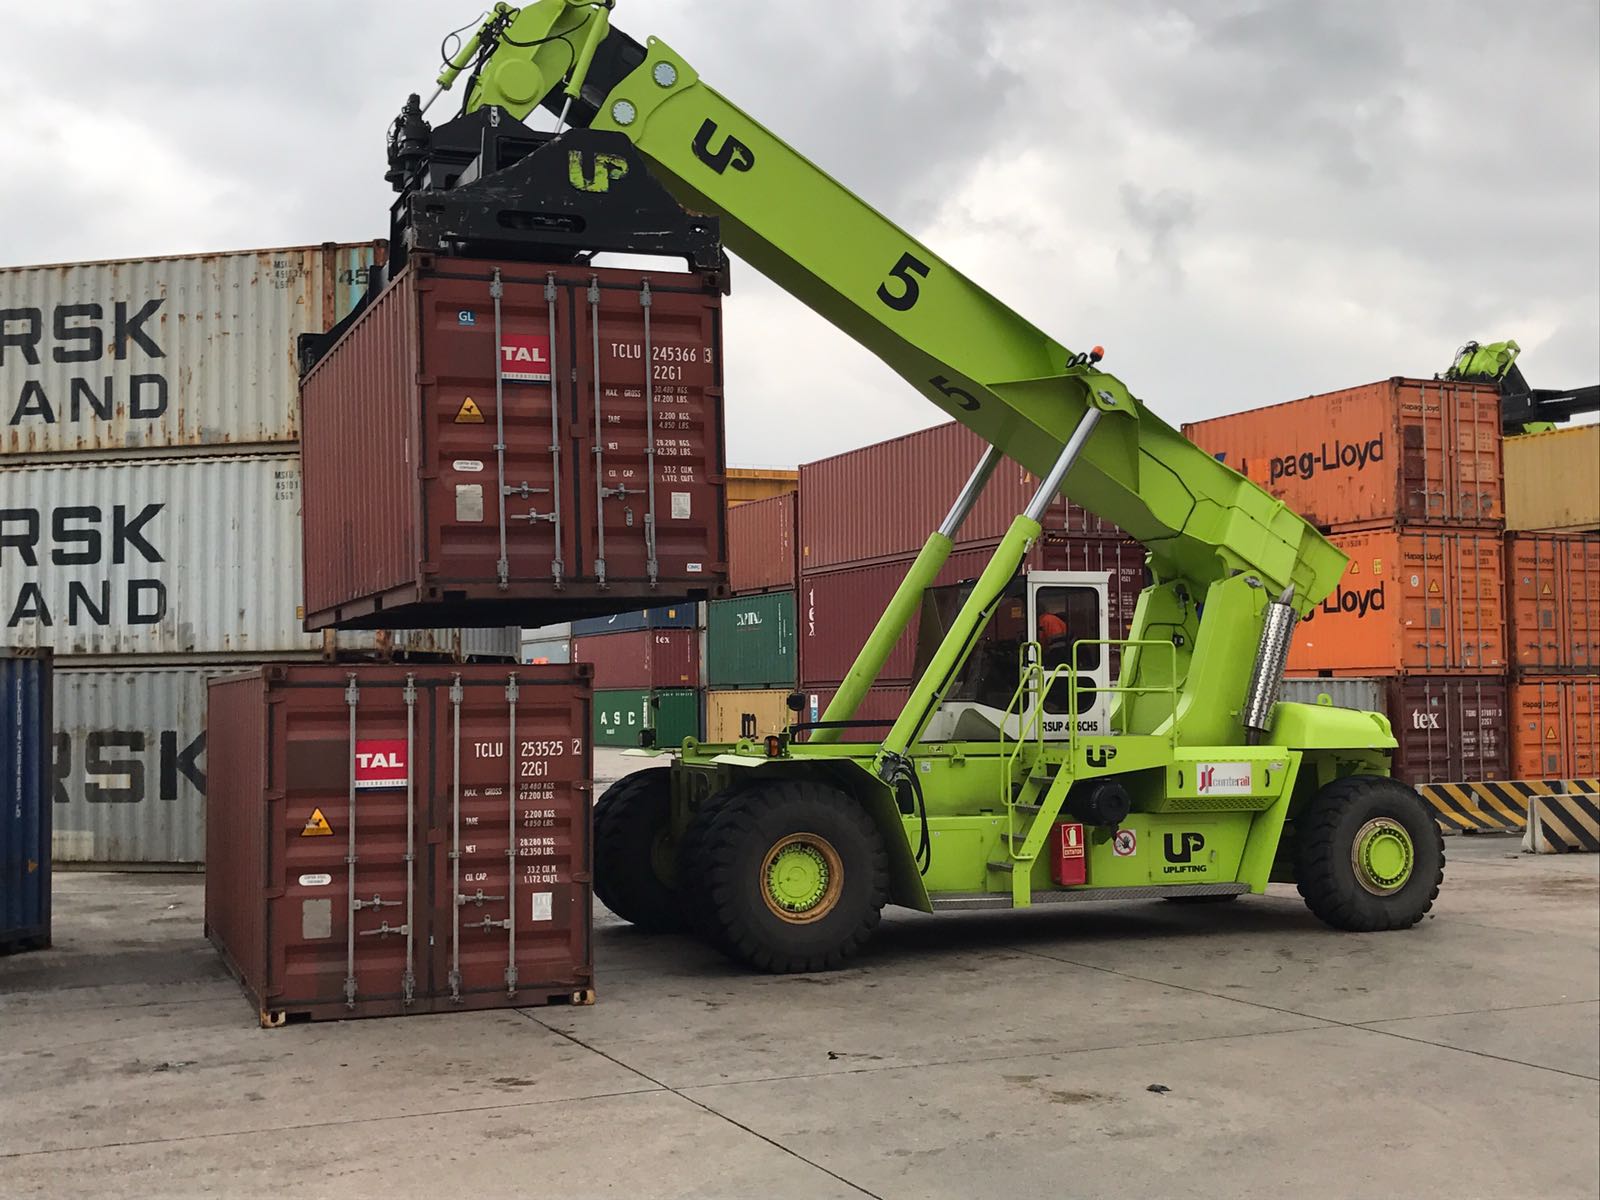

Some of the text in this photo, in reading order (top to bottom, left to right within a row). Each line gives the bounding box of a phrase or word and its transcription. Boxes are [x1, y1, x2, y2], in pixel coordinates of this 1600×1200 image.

[692, 118, 755, 175] UP
[568, 150, 628, 193] UP
[876, 252, 931, 311] 5
[458, 311, 474, 322] GL
[501, 346, 546, 362] TAL
[611, 343, 713, 363] TCLU 245366 3
[653, 366, 682, 380] 22G1
[623, 389, 641, 398] GROSS
[928, 375, 981, 411] 5
[9, 374, 168, 425] AND
[653, 395, 674, 403] 67.200
[608, 442, 619, 450] NET
[664, 466, 677, 474] 33.2
[7, 579, 167, 627] AND
[655, 635, 670, 644] tex
[1412, 708, 1440, 729] tex
[1042, 721, 1064, 732] RSUP
[475, 739, 581, 757] TCLU 253525 2
[356, 753, 404, 768] TAL
[521, 761, 548, 776] 22G1
[485, 787, 503, 796] GROSS
[520, 791, 541, 800] 67.200
[524, 810, 542, 818] 2.200
[465, 816, 479, 825] TARE
[465, 844, 476, 853] NET
[520, 847, 541, 856] 62.350
[1163, 832, 1205, 863] UP
[527, 865, 540, 874] 33.2
[1163, 865, 1207, 874] UPLIFTING
